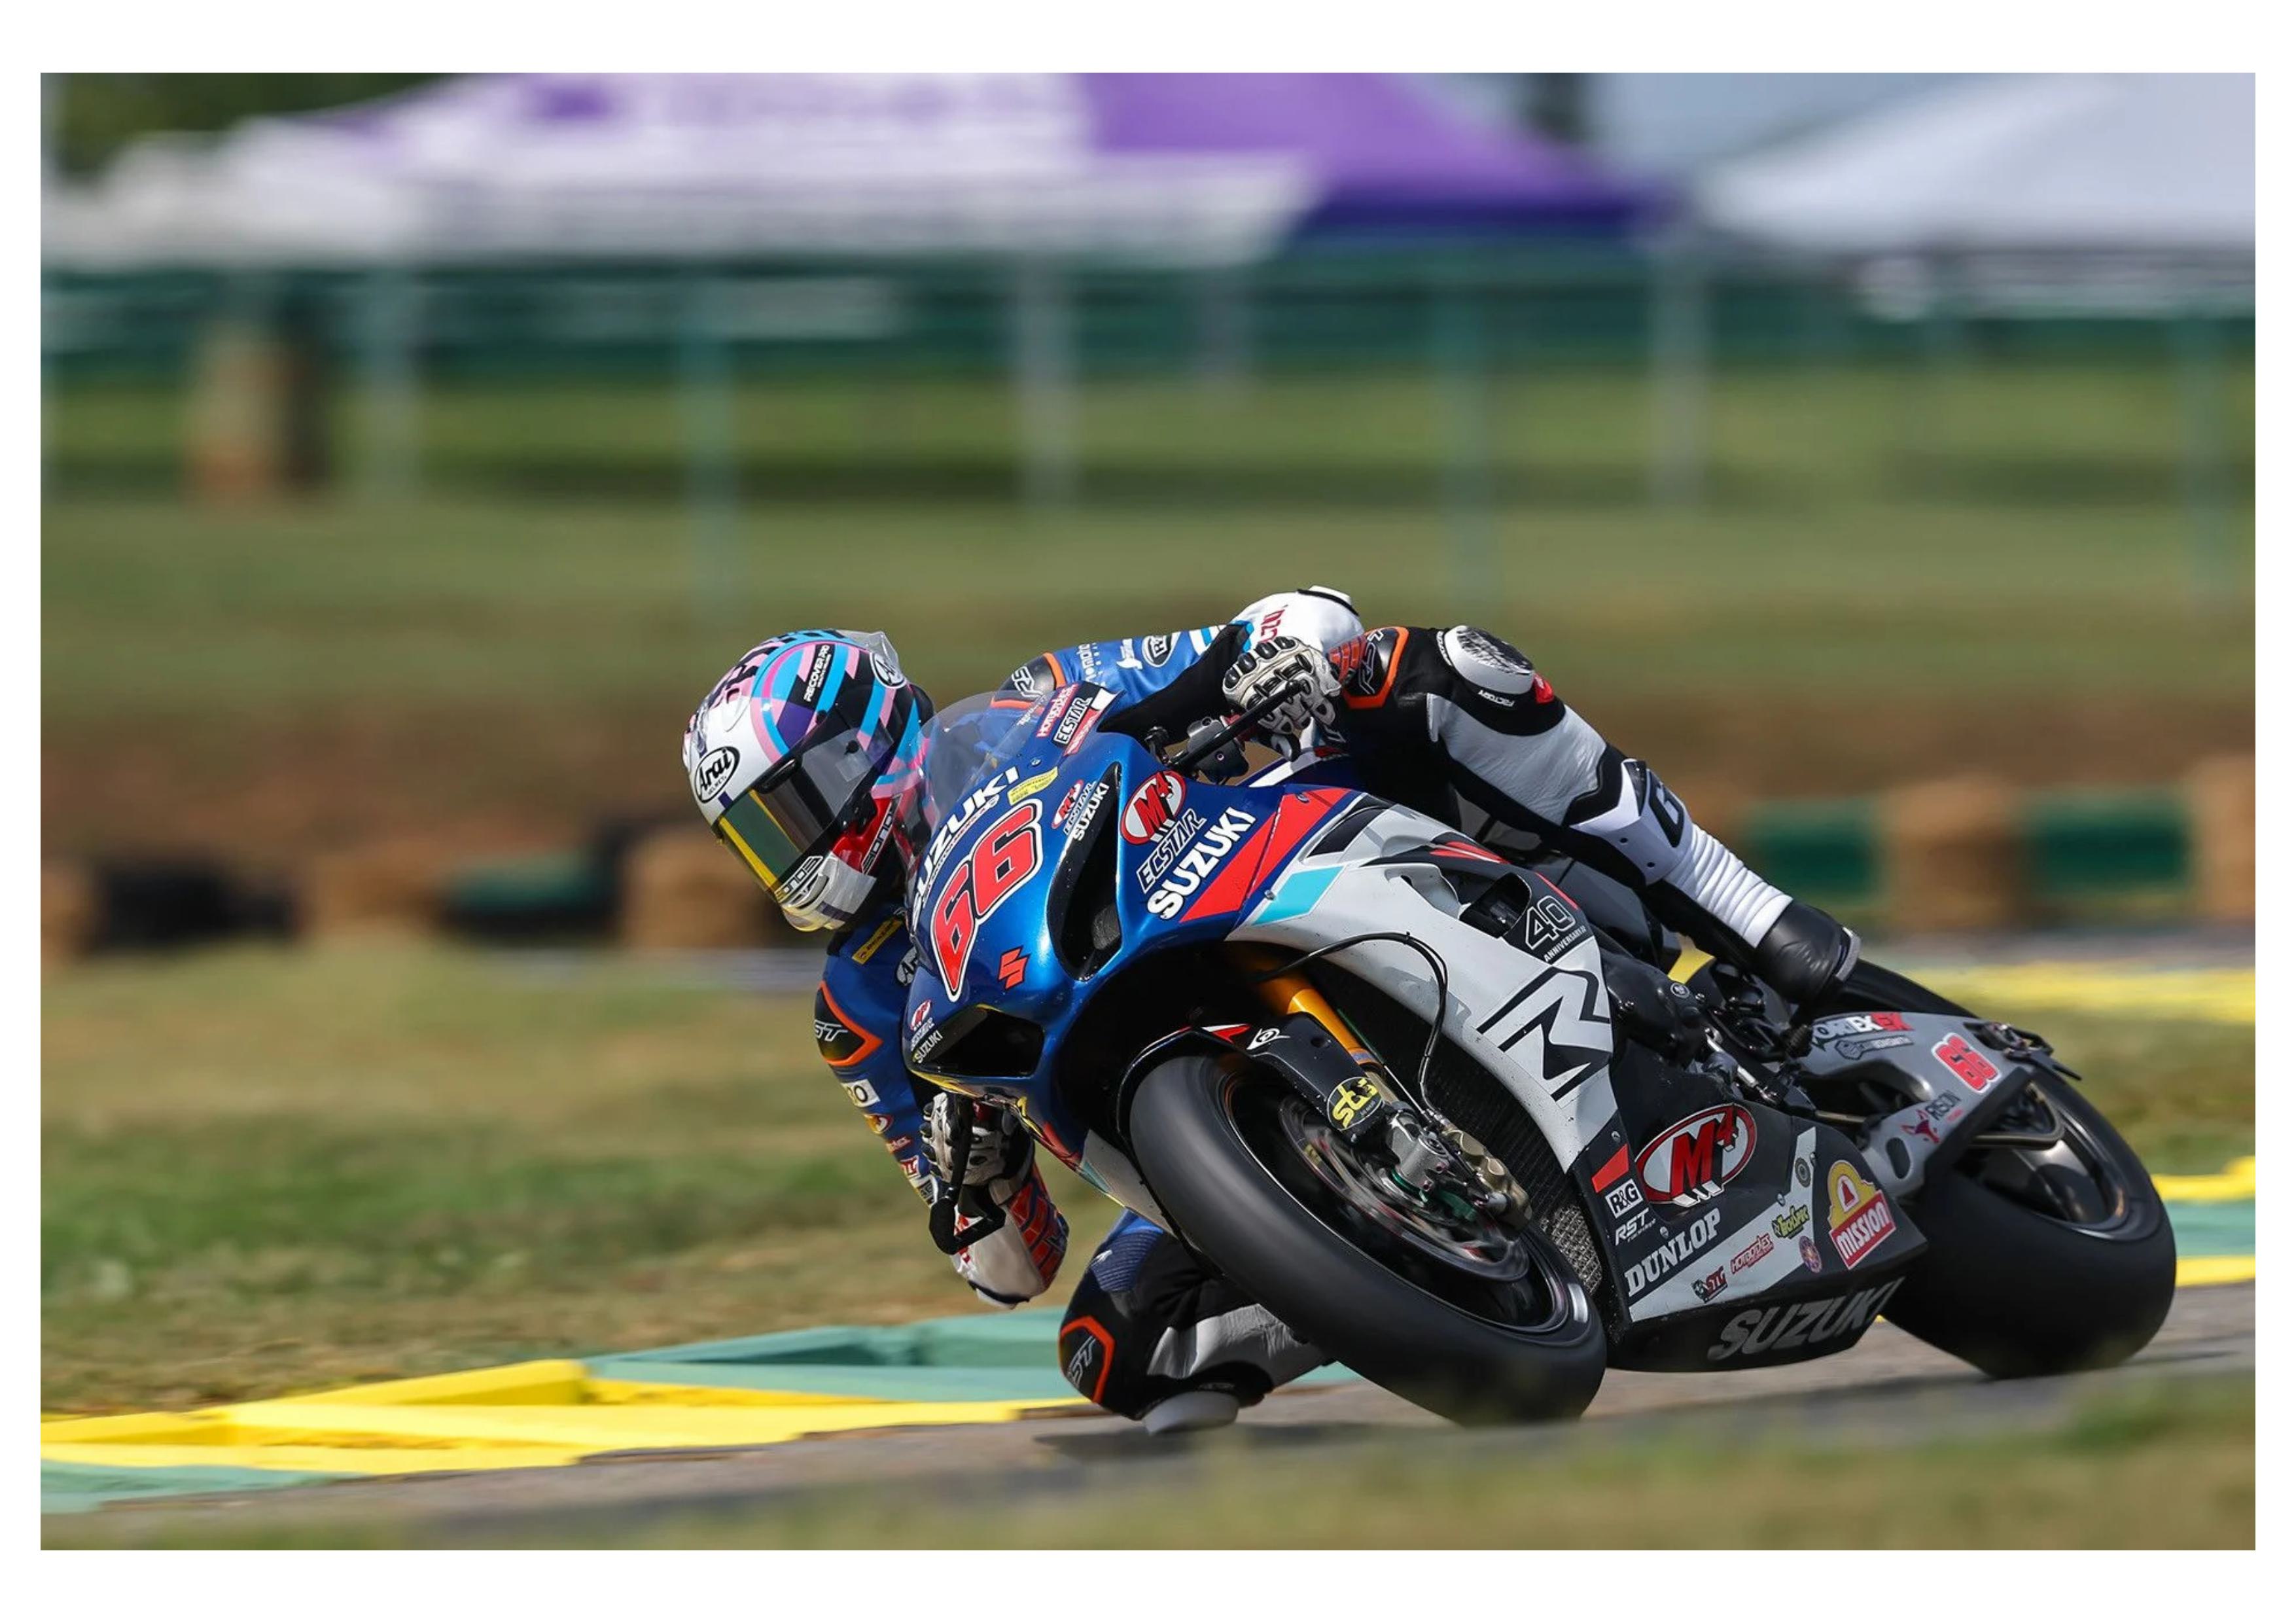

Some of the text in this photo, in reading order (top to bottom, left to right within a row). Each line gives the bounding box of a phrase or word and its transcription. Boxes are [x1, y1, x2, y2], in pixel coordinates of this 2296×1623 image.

[804, 658, 826, 702] RECOVER
[1053, 697, 1093, 744] ECSTAR
[698, 747, 732, 800] Arai
[1073, 782, 1110, 841] SUZUKI
[911, 766, 1019, 933] SUZUKI
[1137, 807, 1207, 895] ECSTAR
[1147, 806, 1256, 920] SUZUKI
[930, 798, 1043, 1003] 66
[1525, 895, 1576, 950] 40
[913, 1029, 943, 1063] SUZUKI
[1609, 1183, 1640, 1215] R&G
[1615, 1207, 1650, 1246] RST
[1624, 1207, 1721, 1298] DUNLOP
[1837, 1201, 1886, 1261] MISSION
[1706, 1277, 1906, 1362] SUZUKI
